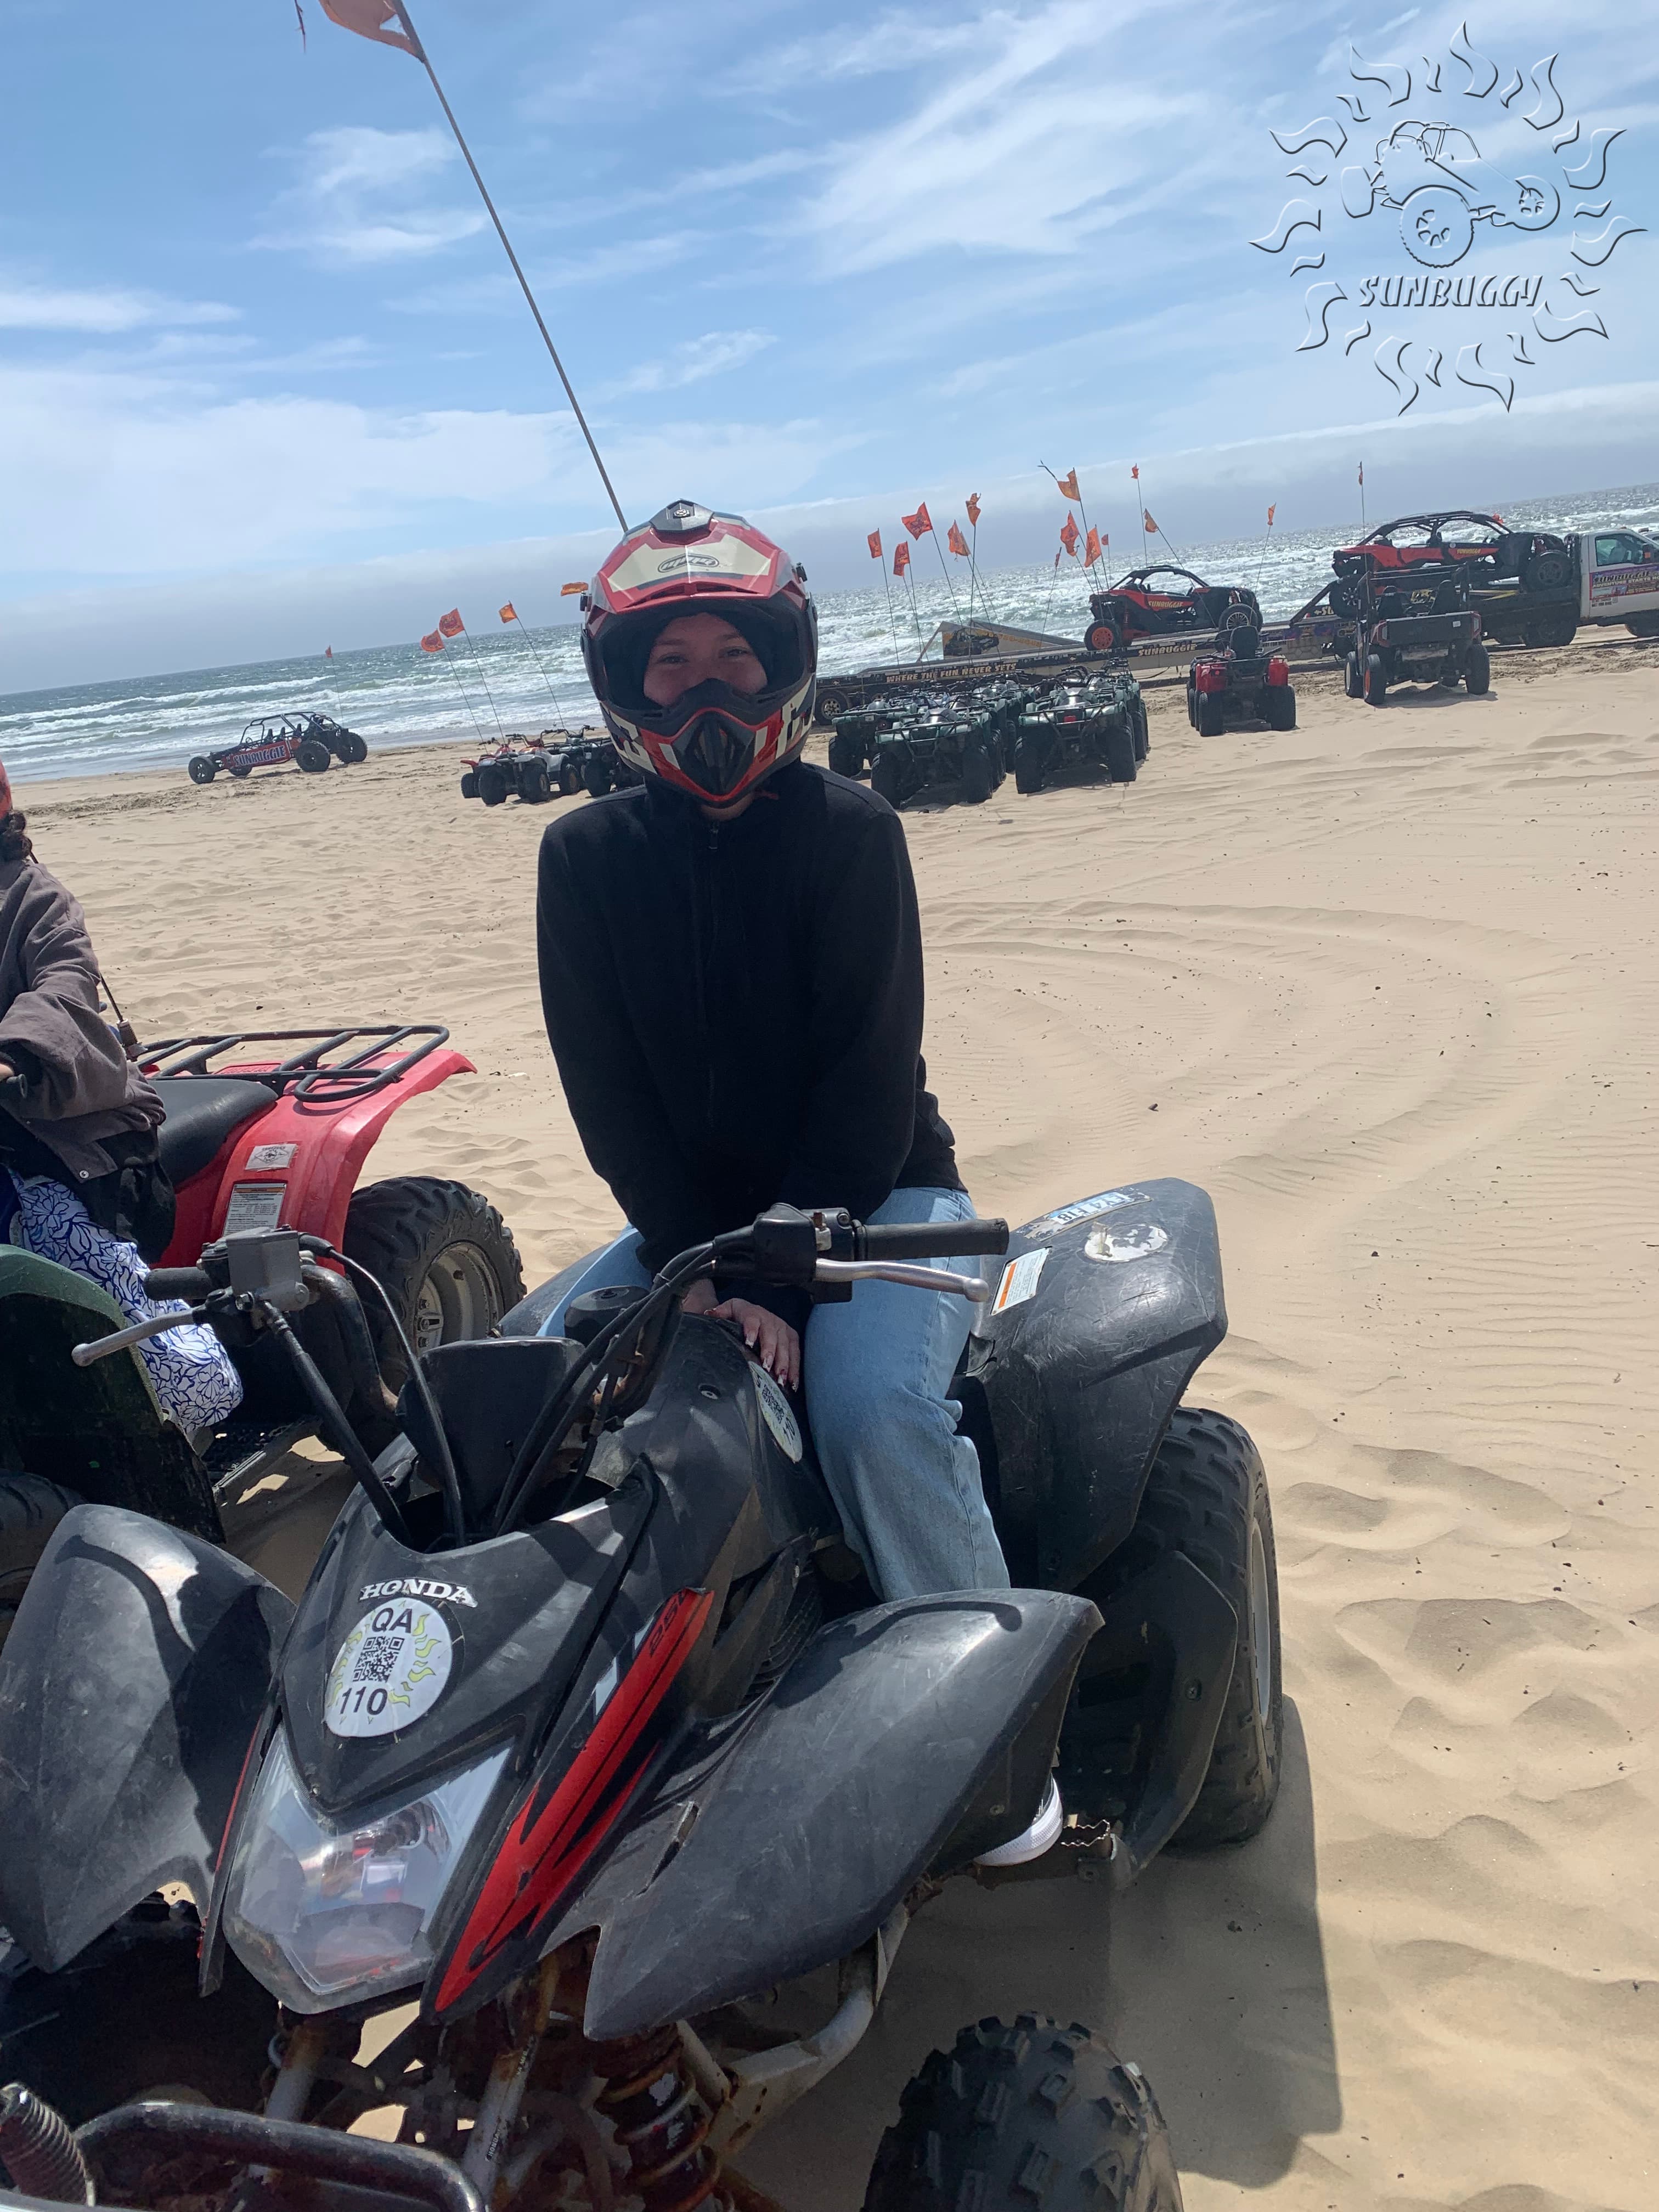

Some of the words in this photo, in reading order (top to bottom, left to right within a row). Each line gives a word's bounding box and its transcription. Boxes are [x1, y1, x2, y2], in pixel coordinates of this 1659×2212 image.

[1138, 644, 1197, 656] SUNBUGGIE
[886, 674, 918, 682] WHERE
[922, 672, 938, 680] THE
[940, 669, 959, 677] FUN
[962, 665, 991, 675] NEVER
[995, 663, 1017, 672] SETS
[233, 746, 286, 766] SUNBUGGIE
[360, 1579, 478, 1608] HONDA
[371, 1607, 413, 1634] QA
[339, 1686, 388, 1716] 110
